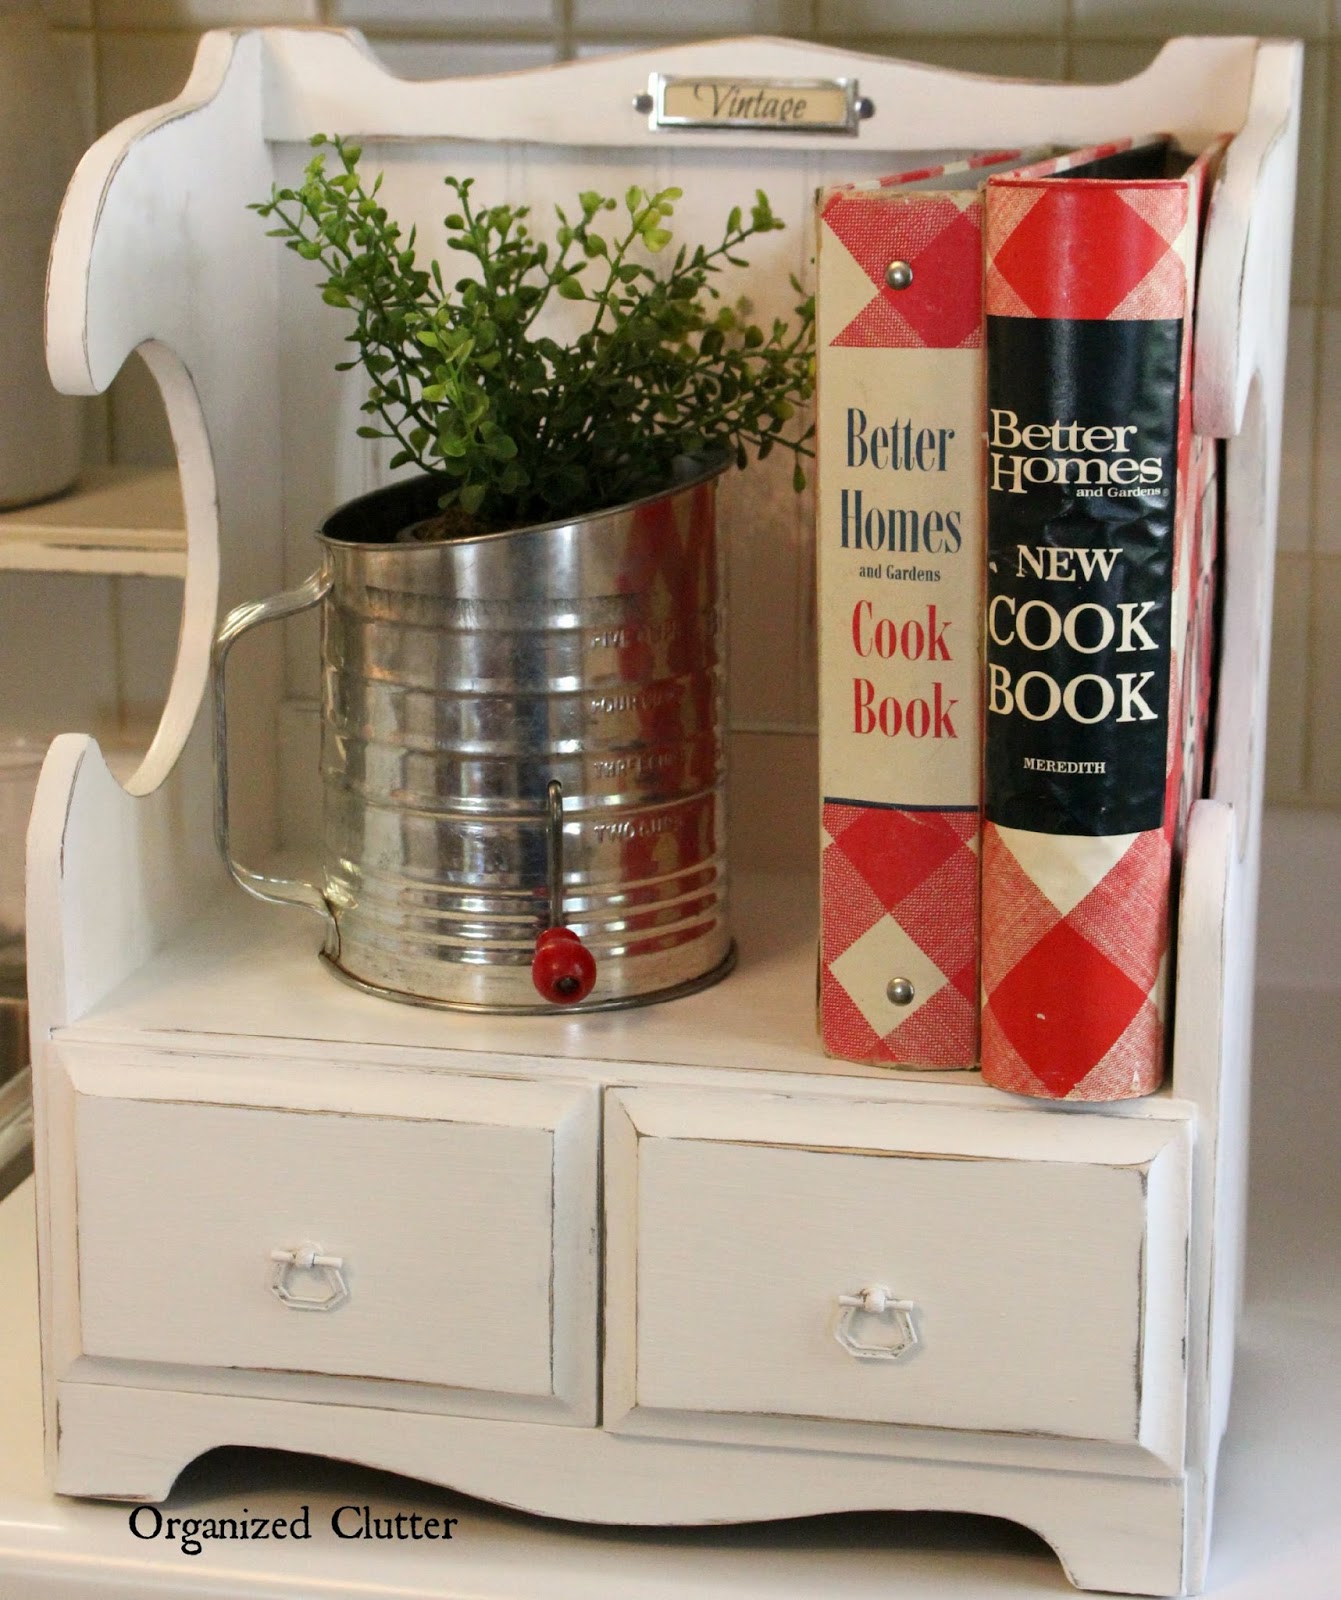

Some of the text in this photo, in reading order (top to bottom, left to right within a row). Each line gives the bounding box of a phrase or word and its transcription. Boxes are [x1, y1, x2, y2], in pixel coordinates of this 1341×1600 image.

[693, 83, 808, 122] Vintage
[847, 407, 955, 472] Better
[990, 408, 1138, 453] Better
[990, 452, 1163, 494] Homes
[1075, 486, 1161, 498] and Gardens
[840, 488, 962, 554] Homes
[859, 563, 941, 582] and Gardens
[1015, 544, 1124, 582] NEW
[852, 599, 953, 661] Cook
[989, 595, 1159, 654] COOK
[853, 677, 960, 739] Book
[988, 663, 1159, 725] BOOK
[1023, 757, 1107, 774] MEREDITH
